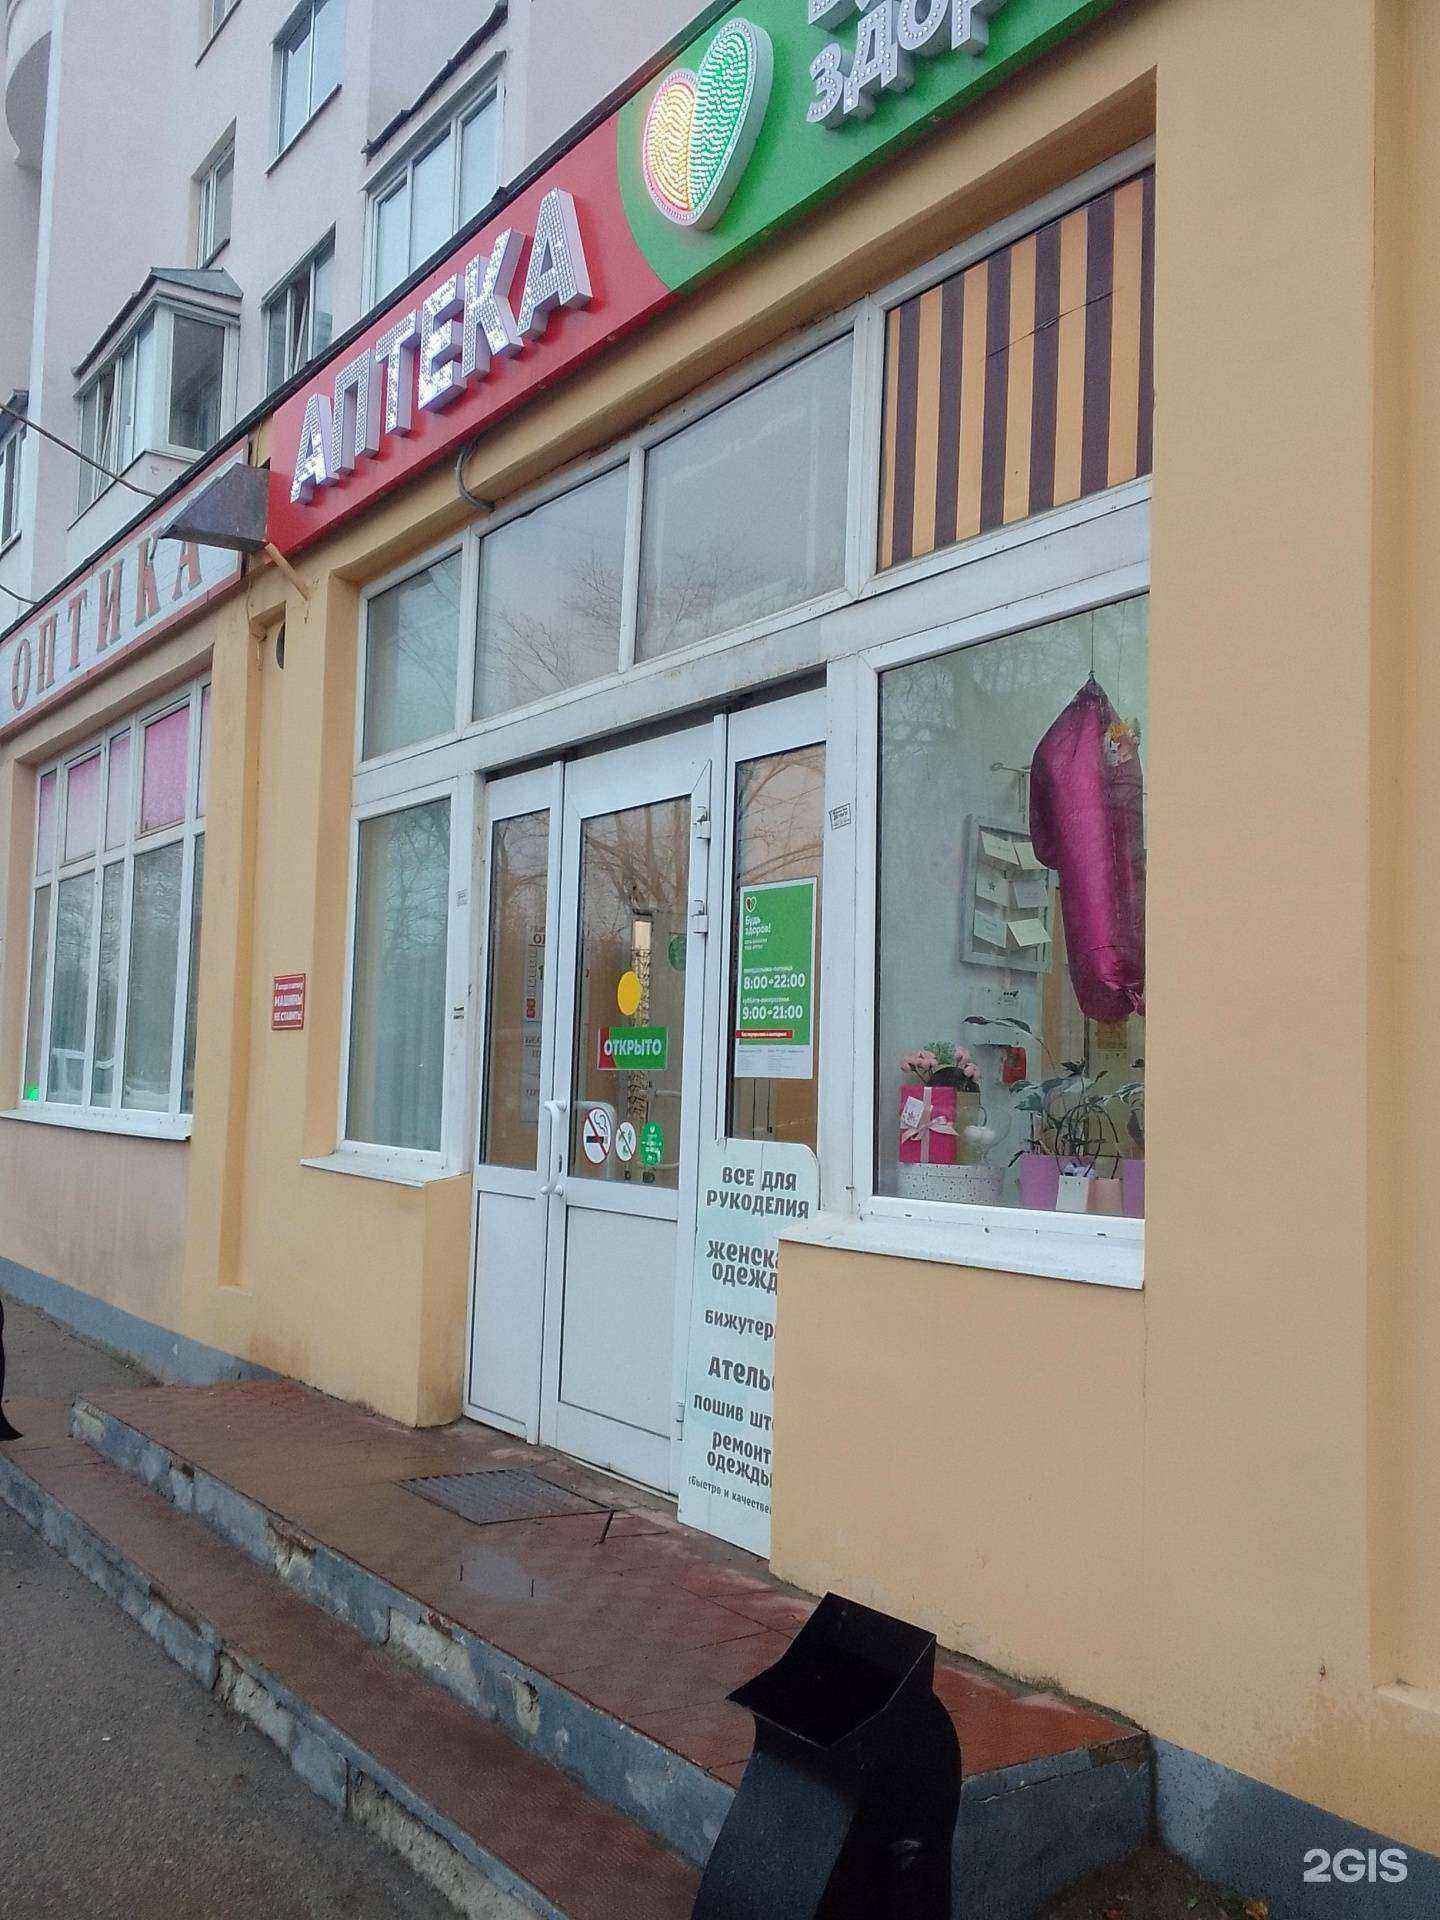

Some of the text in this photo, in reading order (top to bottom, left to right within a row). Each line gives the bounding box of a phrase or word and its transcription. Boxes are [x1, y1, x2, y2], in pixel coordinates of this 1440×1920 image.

[290, 187, 592, 504] АПТЕКА
[10, 531, 203, 711] ОПТИКА
[603, 1038, 662, 1056] ОТКРЫТО
[721, 1166, 797, 1192] ВСЕ ДЛЯ
[706, 1189, 809, 1219] РУКОДЕЛИЯ
[749, 1410, 774, 1431] шт
